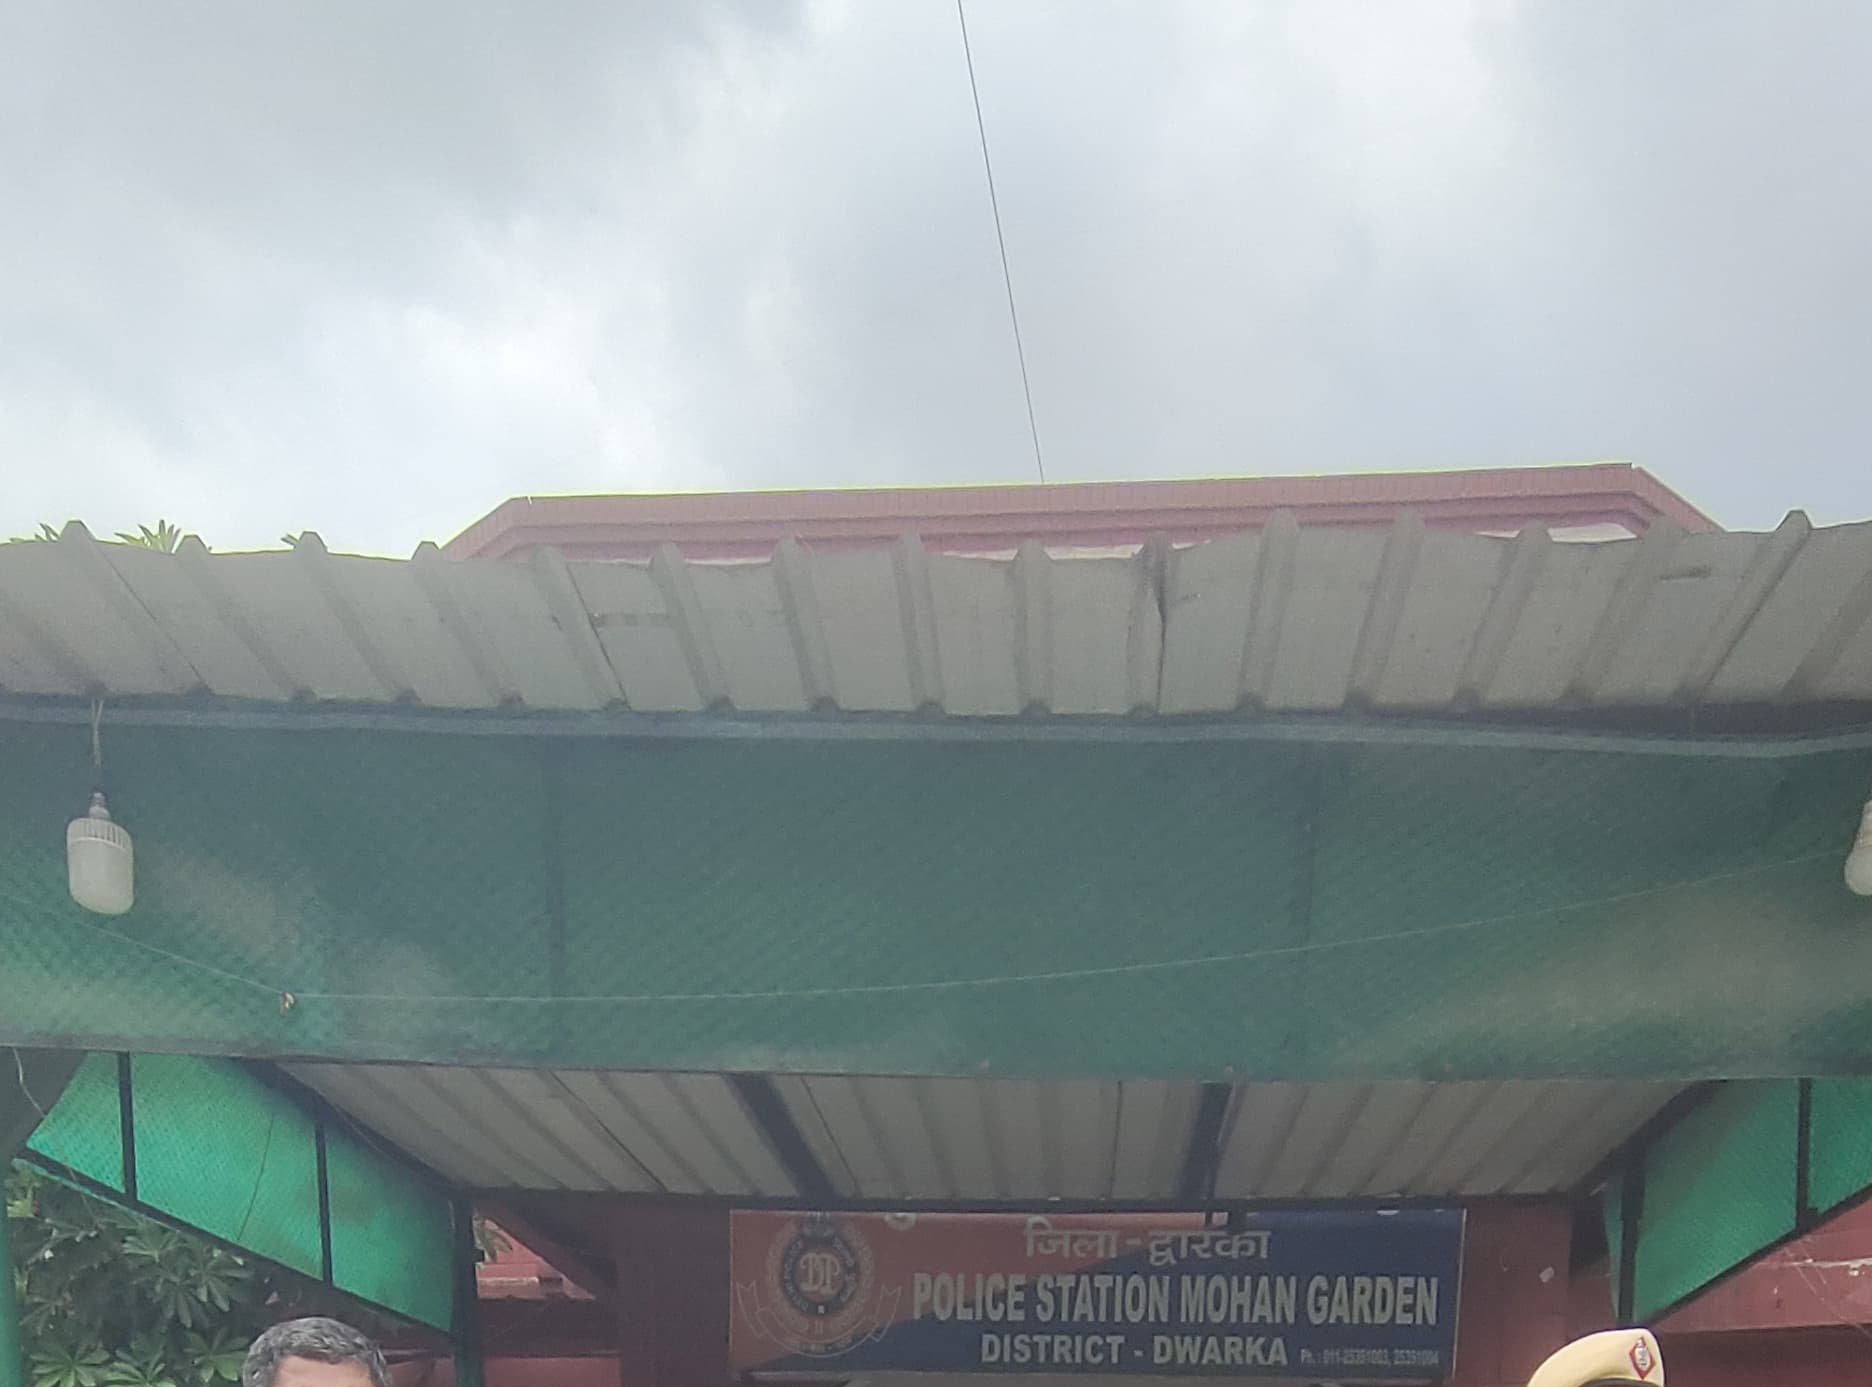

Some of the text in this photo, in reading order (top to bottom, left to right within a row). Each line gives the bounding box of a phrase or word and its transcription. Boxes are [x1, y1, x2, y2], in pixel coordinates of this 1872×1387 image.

[912, 1272, 1026, 1321] POLICE
[1036, 1273, 1169, 1323] STATION
[1180, 1275, 1296, 1325] MOHAN
[1307, 1275, 1438, 1325] GARDEN
[981, 1334, 1125, 1363] DISTRICT
[1153, 1336, 1288, 1365] DWARKA
